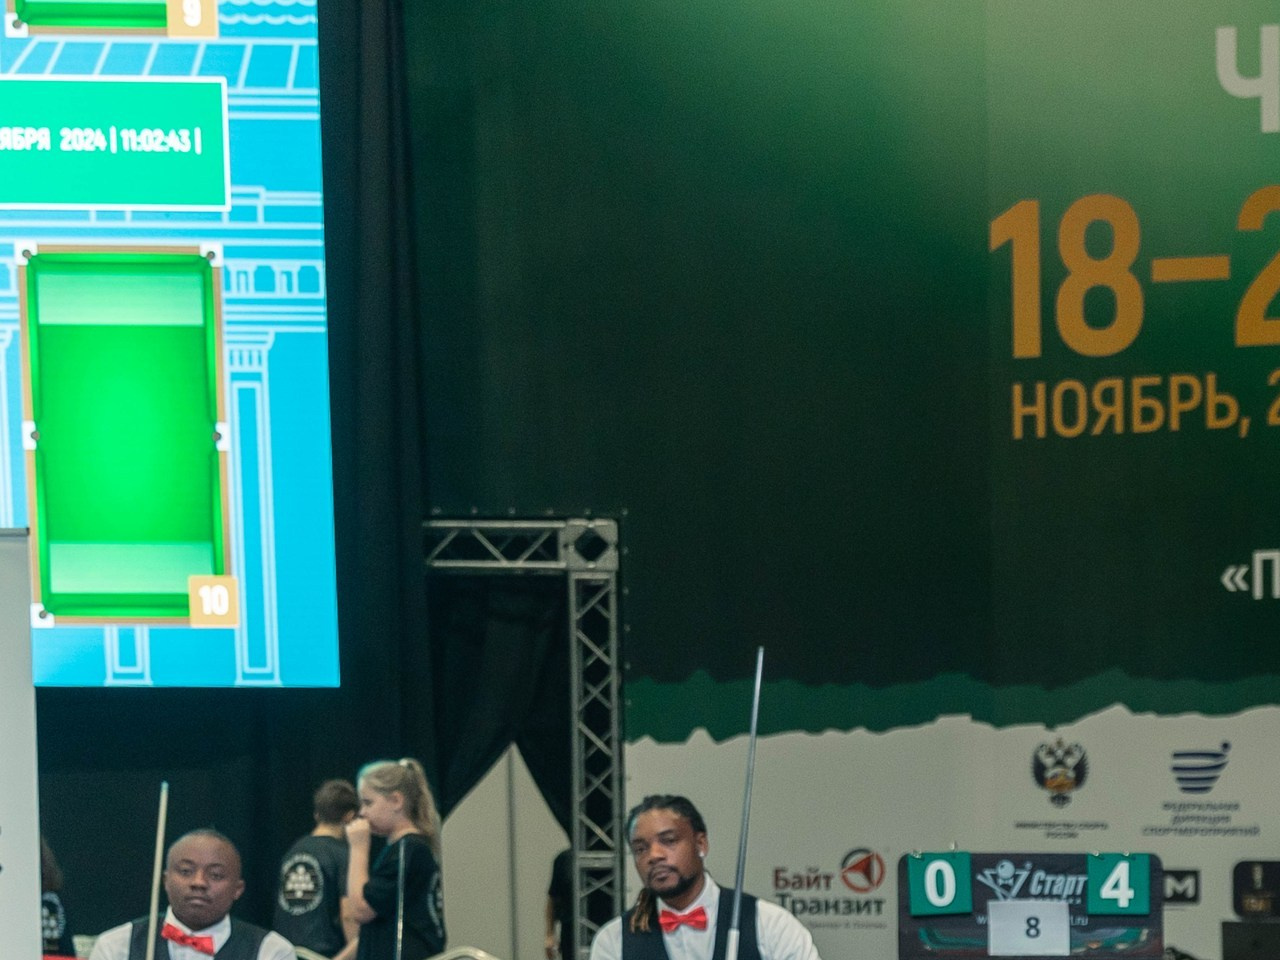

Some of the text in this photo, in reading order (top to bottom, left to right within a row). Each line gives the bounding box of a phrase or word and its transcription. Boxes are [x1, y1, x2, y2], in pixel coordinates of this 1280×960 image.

[59, 127, 107, 151] 2024
[1012, 373, 1251, 440] НОЯБРЬ,
[198, 585, 229, 615] 10
[774, 866, 834, 891] Байт
[924, 859, 956, 907] 0
[1029, 869, 1088, 898] Старт
[1100, 861, 1135, 908] 4
[775, 892, 885, 916] Транзит
[1026, 916, 1041, 938] 8
